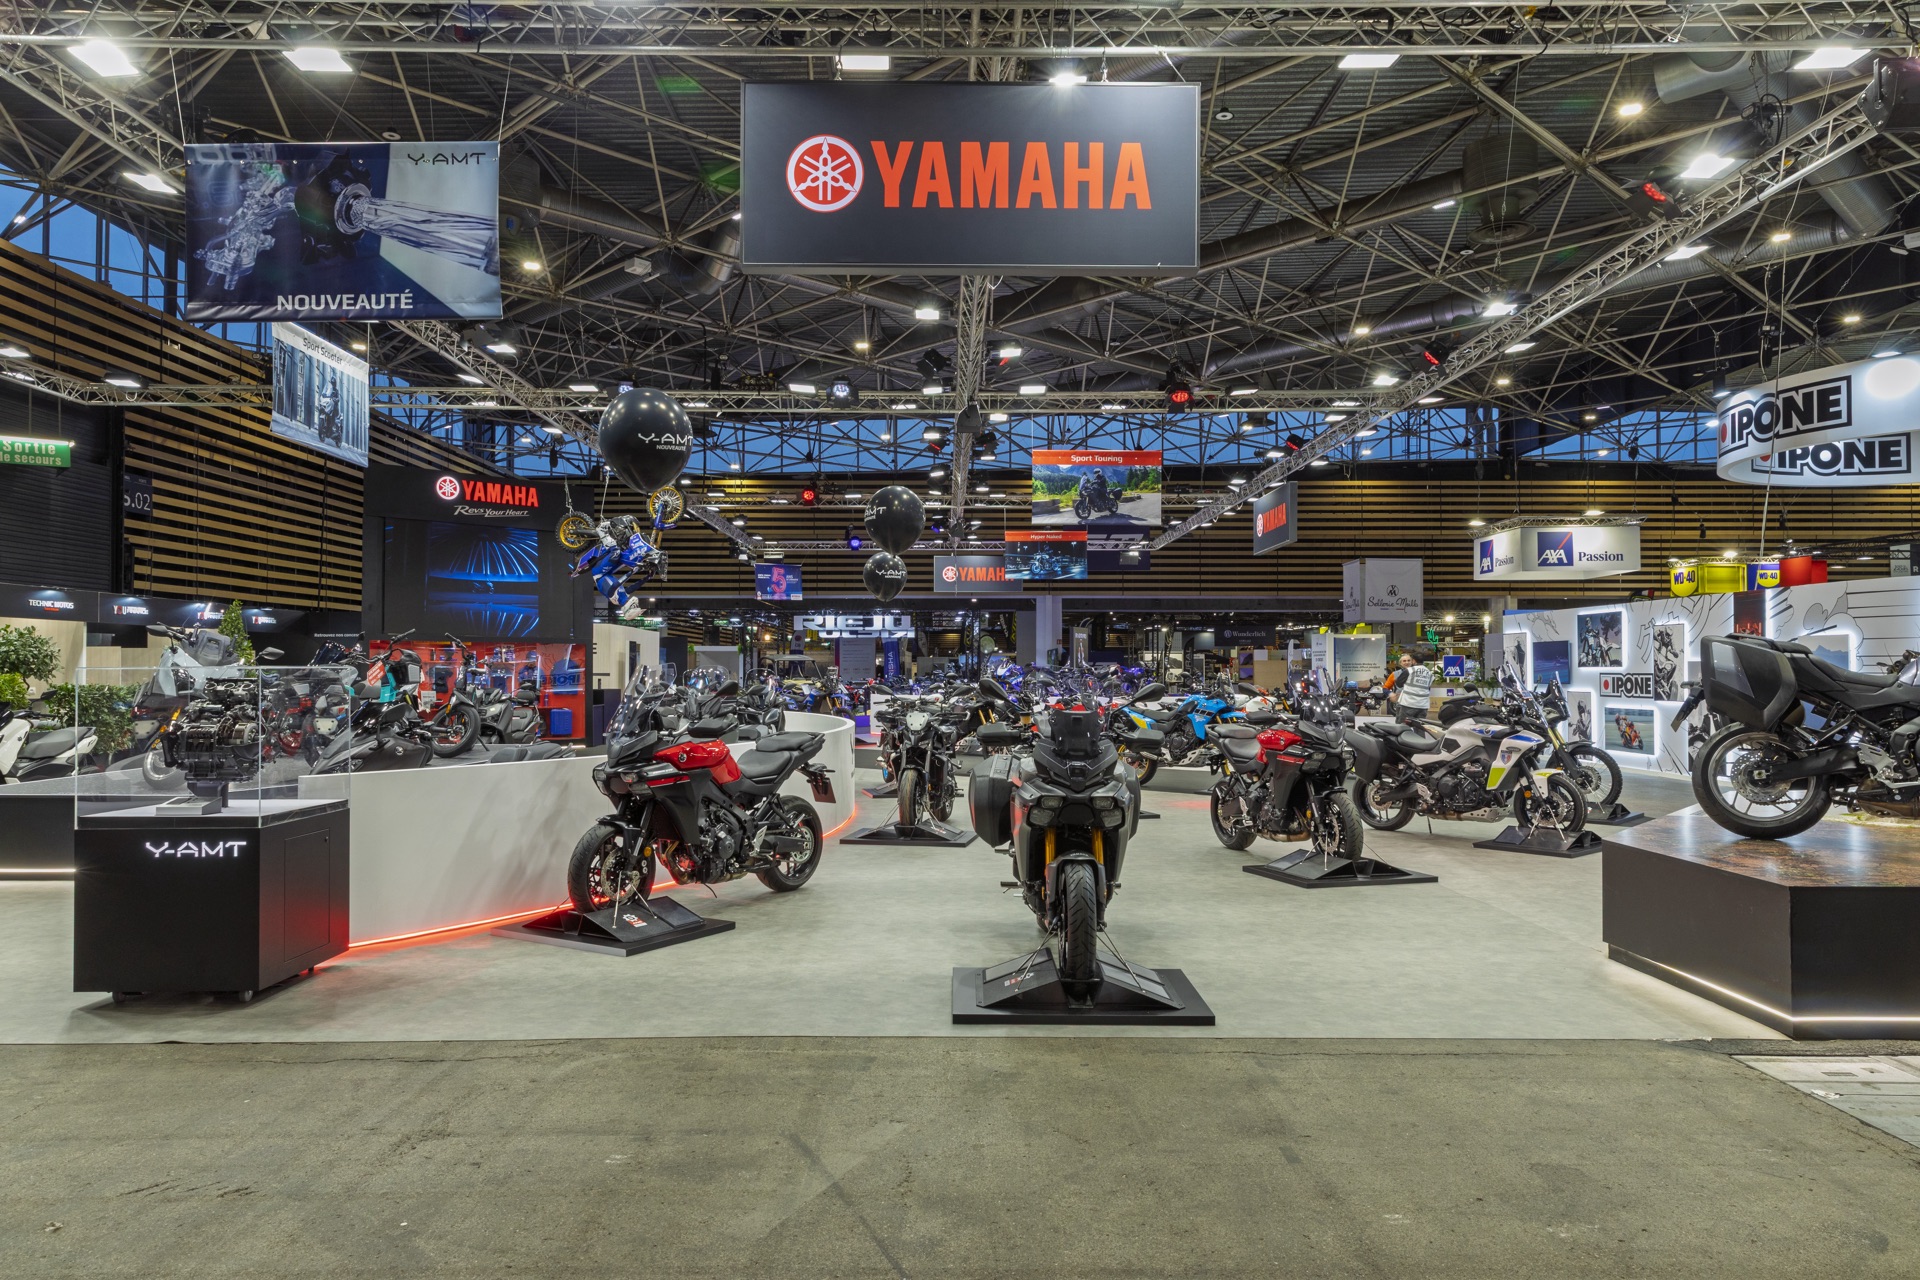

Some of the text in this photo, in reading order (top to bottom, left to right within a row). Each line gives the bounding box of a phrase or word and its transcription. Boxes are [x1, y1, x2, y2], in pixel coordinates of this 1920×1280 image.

[870, 140, 1152, 210] YAMAHA
[277, 289, 414, 311] NOUVEAUTÉ
[303, 337, 343, 365] Sport Scooter
[1731, 385, 1843, 444] IPONE
[637, 432, 694, 446] Y-AMT
[2, 440, 56, 455] Sortie
[1778, 439, 1902, 470] IPONE
[14, 454, 62, 466] secours
[1071, 454, 1123, 464] Sport Touring
[462, 479, 539, 508] YAMAHA
[454, 504, 485, 516] Revs
[484, 508, 506, 517] Your
[1263, 502, 1287, 534] YAMAHA
[1480, 554, 1515, 571] AXA Passion
[1538, 549, 1624, 564] AXA Passion
[959, 567, 1014, 582] YAMAH
[1673, 569, 1696, 585] WD-40
[1759, 572, 1778, 580] WD-40
[793, 615, 912, 631] RIEJU
[1424, 624, 1453, 632] Sifam
[1444, 666, 1462, 675] AXA
[1611, 676, 1652, 695] IPONE
[145, 841, 247, 858] Y-AMT
